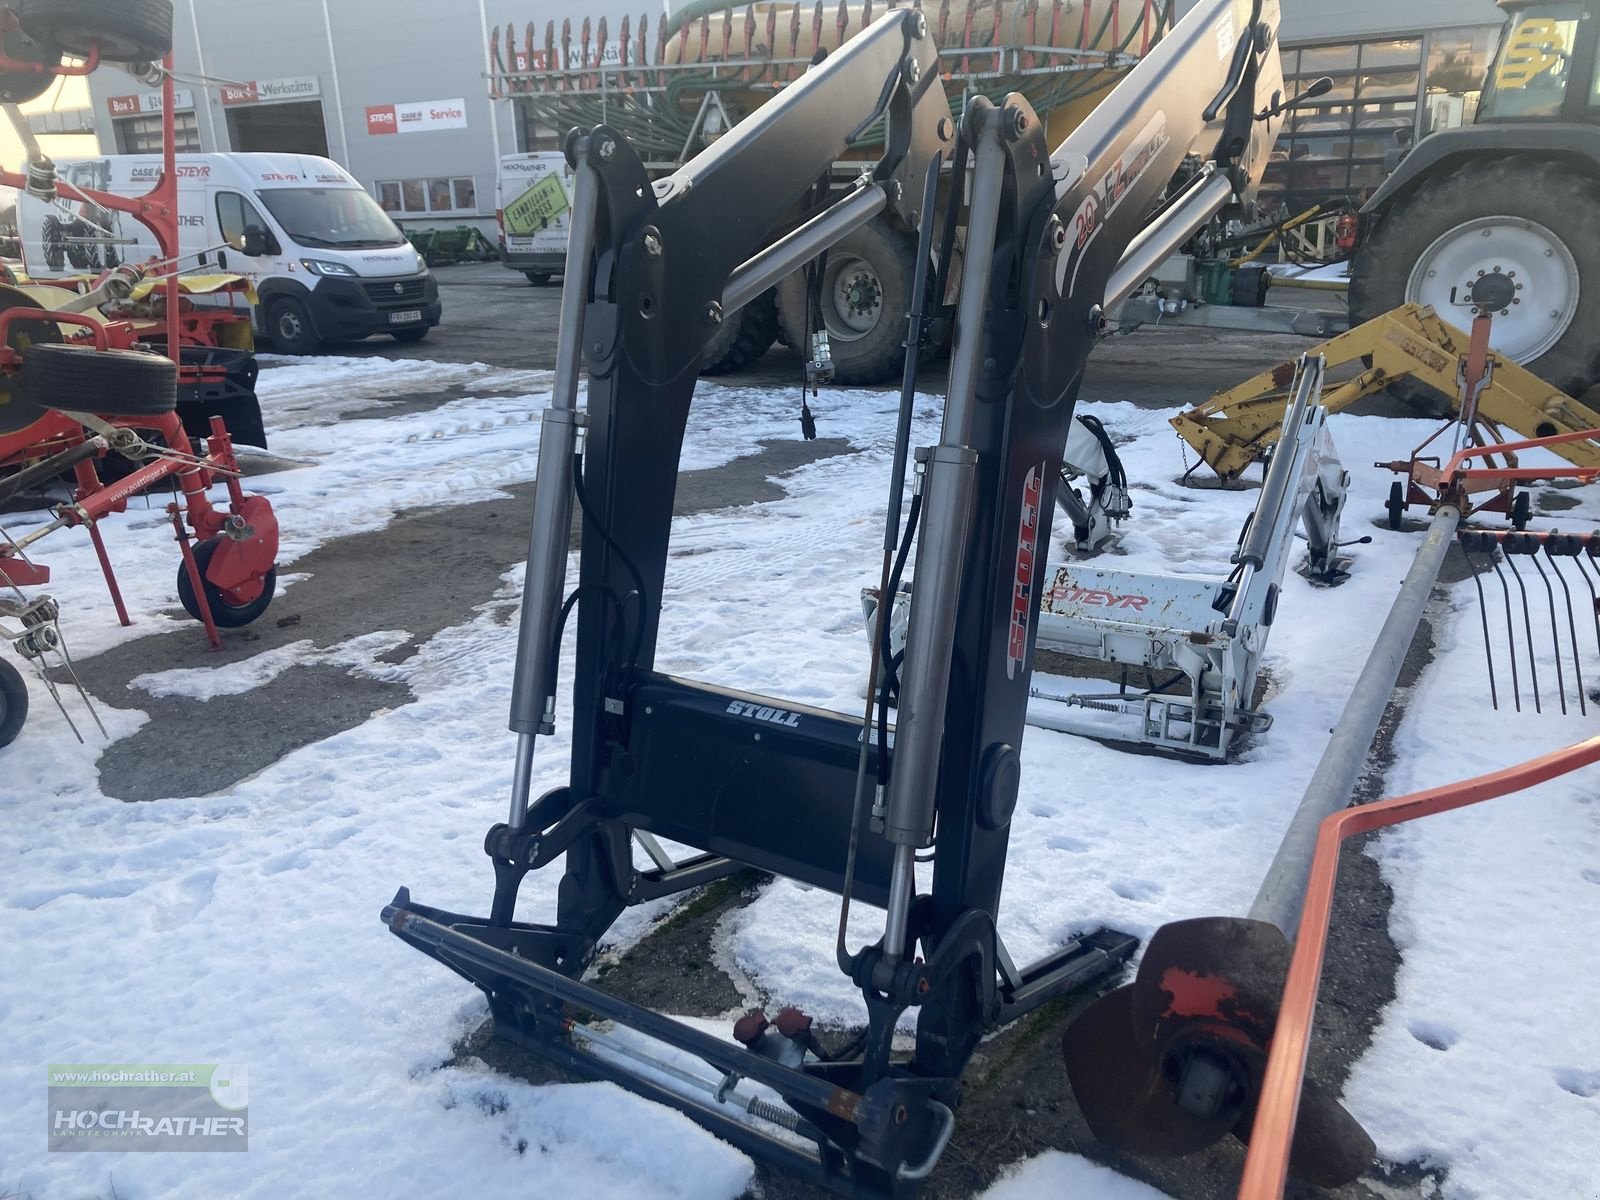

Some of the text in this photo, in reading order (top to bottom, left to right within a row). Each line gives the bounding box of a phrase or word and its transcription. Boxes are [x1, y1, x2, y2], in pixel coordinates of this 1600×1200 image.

[262, 80, 314, 95] Werkstätte
[112, 98, 134, 112] Box 3
[369, 112, 395, 123] STEYR
[429, 107, 462, 120] Service
[131, 168, 154, 177] CASE
[176, 165, 211, 177] STEYR
[1075, 200, 1095, 250] 20
[1008, 476, 1041, 662] STOLL
[1052, 585, 1149, 612] STEYR
[725, 699, 802, 728] STOLL
